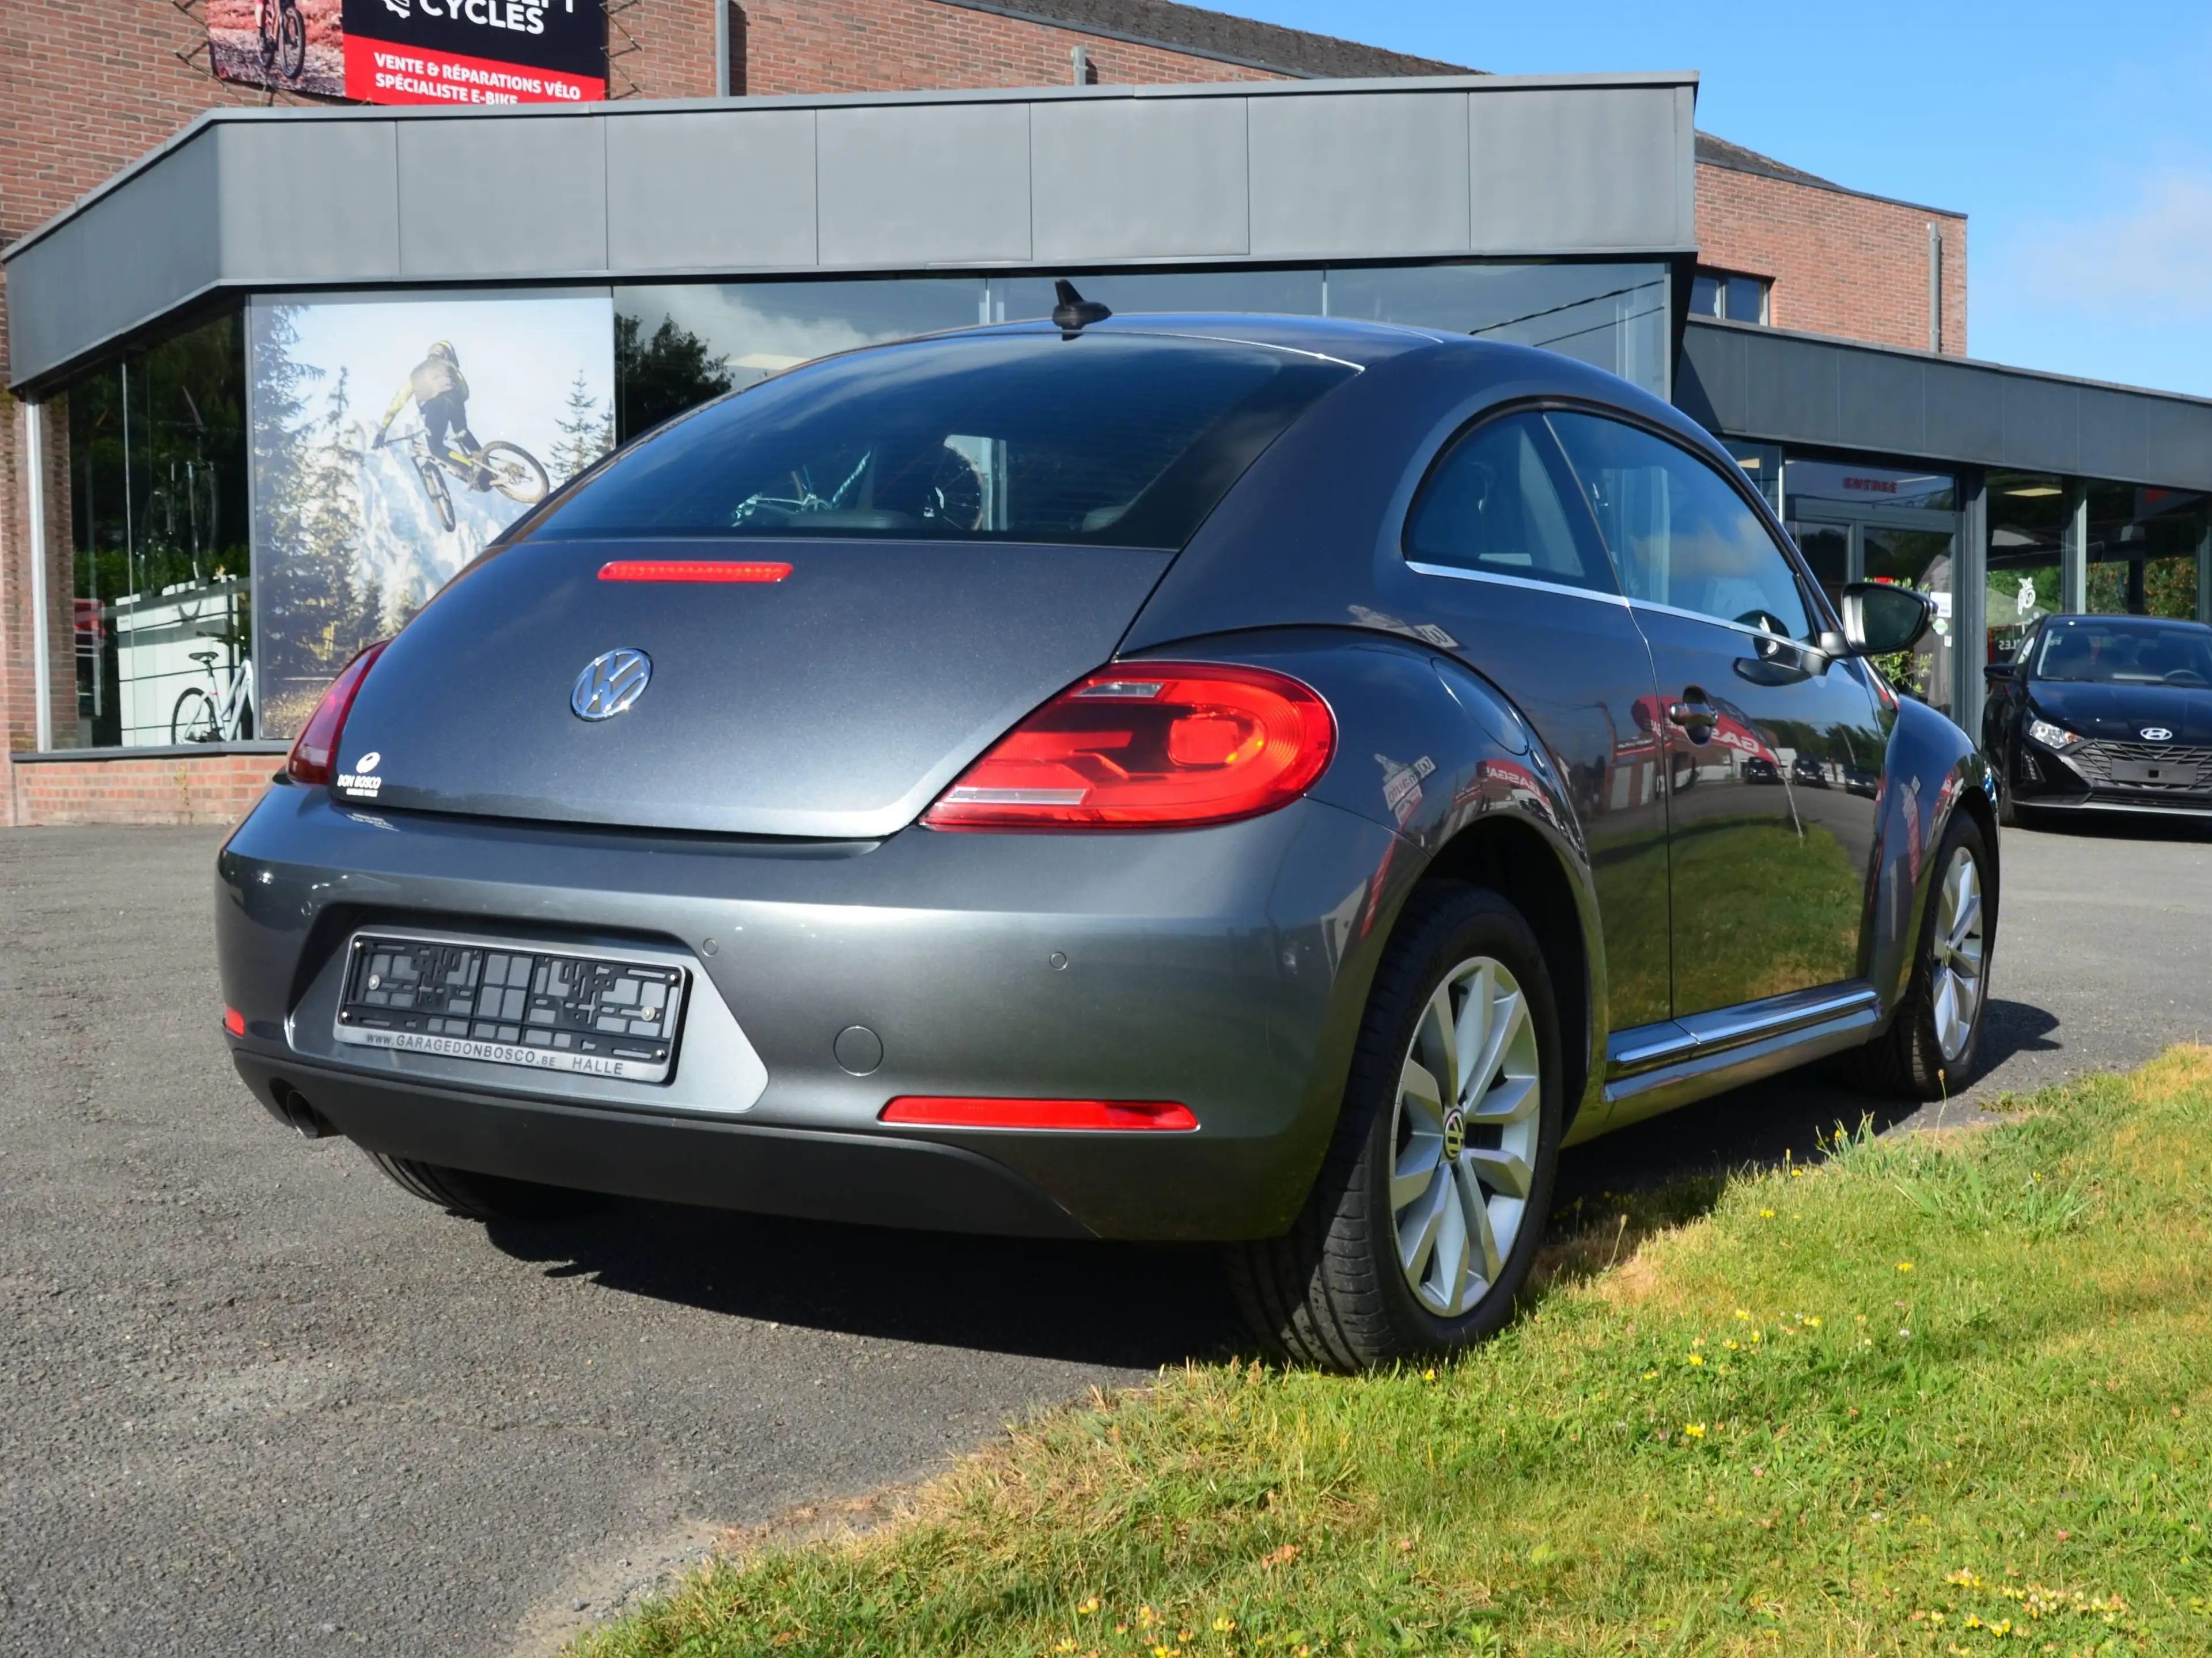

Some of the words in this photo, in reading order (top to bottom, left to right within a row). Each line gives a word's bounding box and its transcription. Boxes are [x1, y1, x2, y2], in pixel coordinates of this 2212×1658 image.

[420, 0, 544, 35] CYCLES
[374, 52, 424, 75] VENTE
[427, 62, 440, 77] &
[442, 64, 541, 93] RÉPARATIONS
[544, 81, 581, 100] VÉLO
[375, 73, 468, 101] SPÉCIALISTE
[471, 89, 518, 104] E-BIKE
[572, 1057, 624, 1075] HALLE
